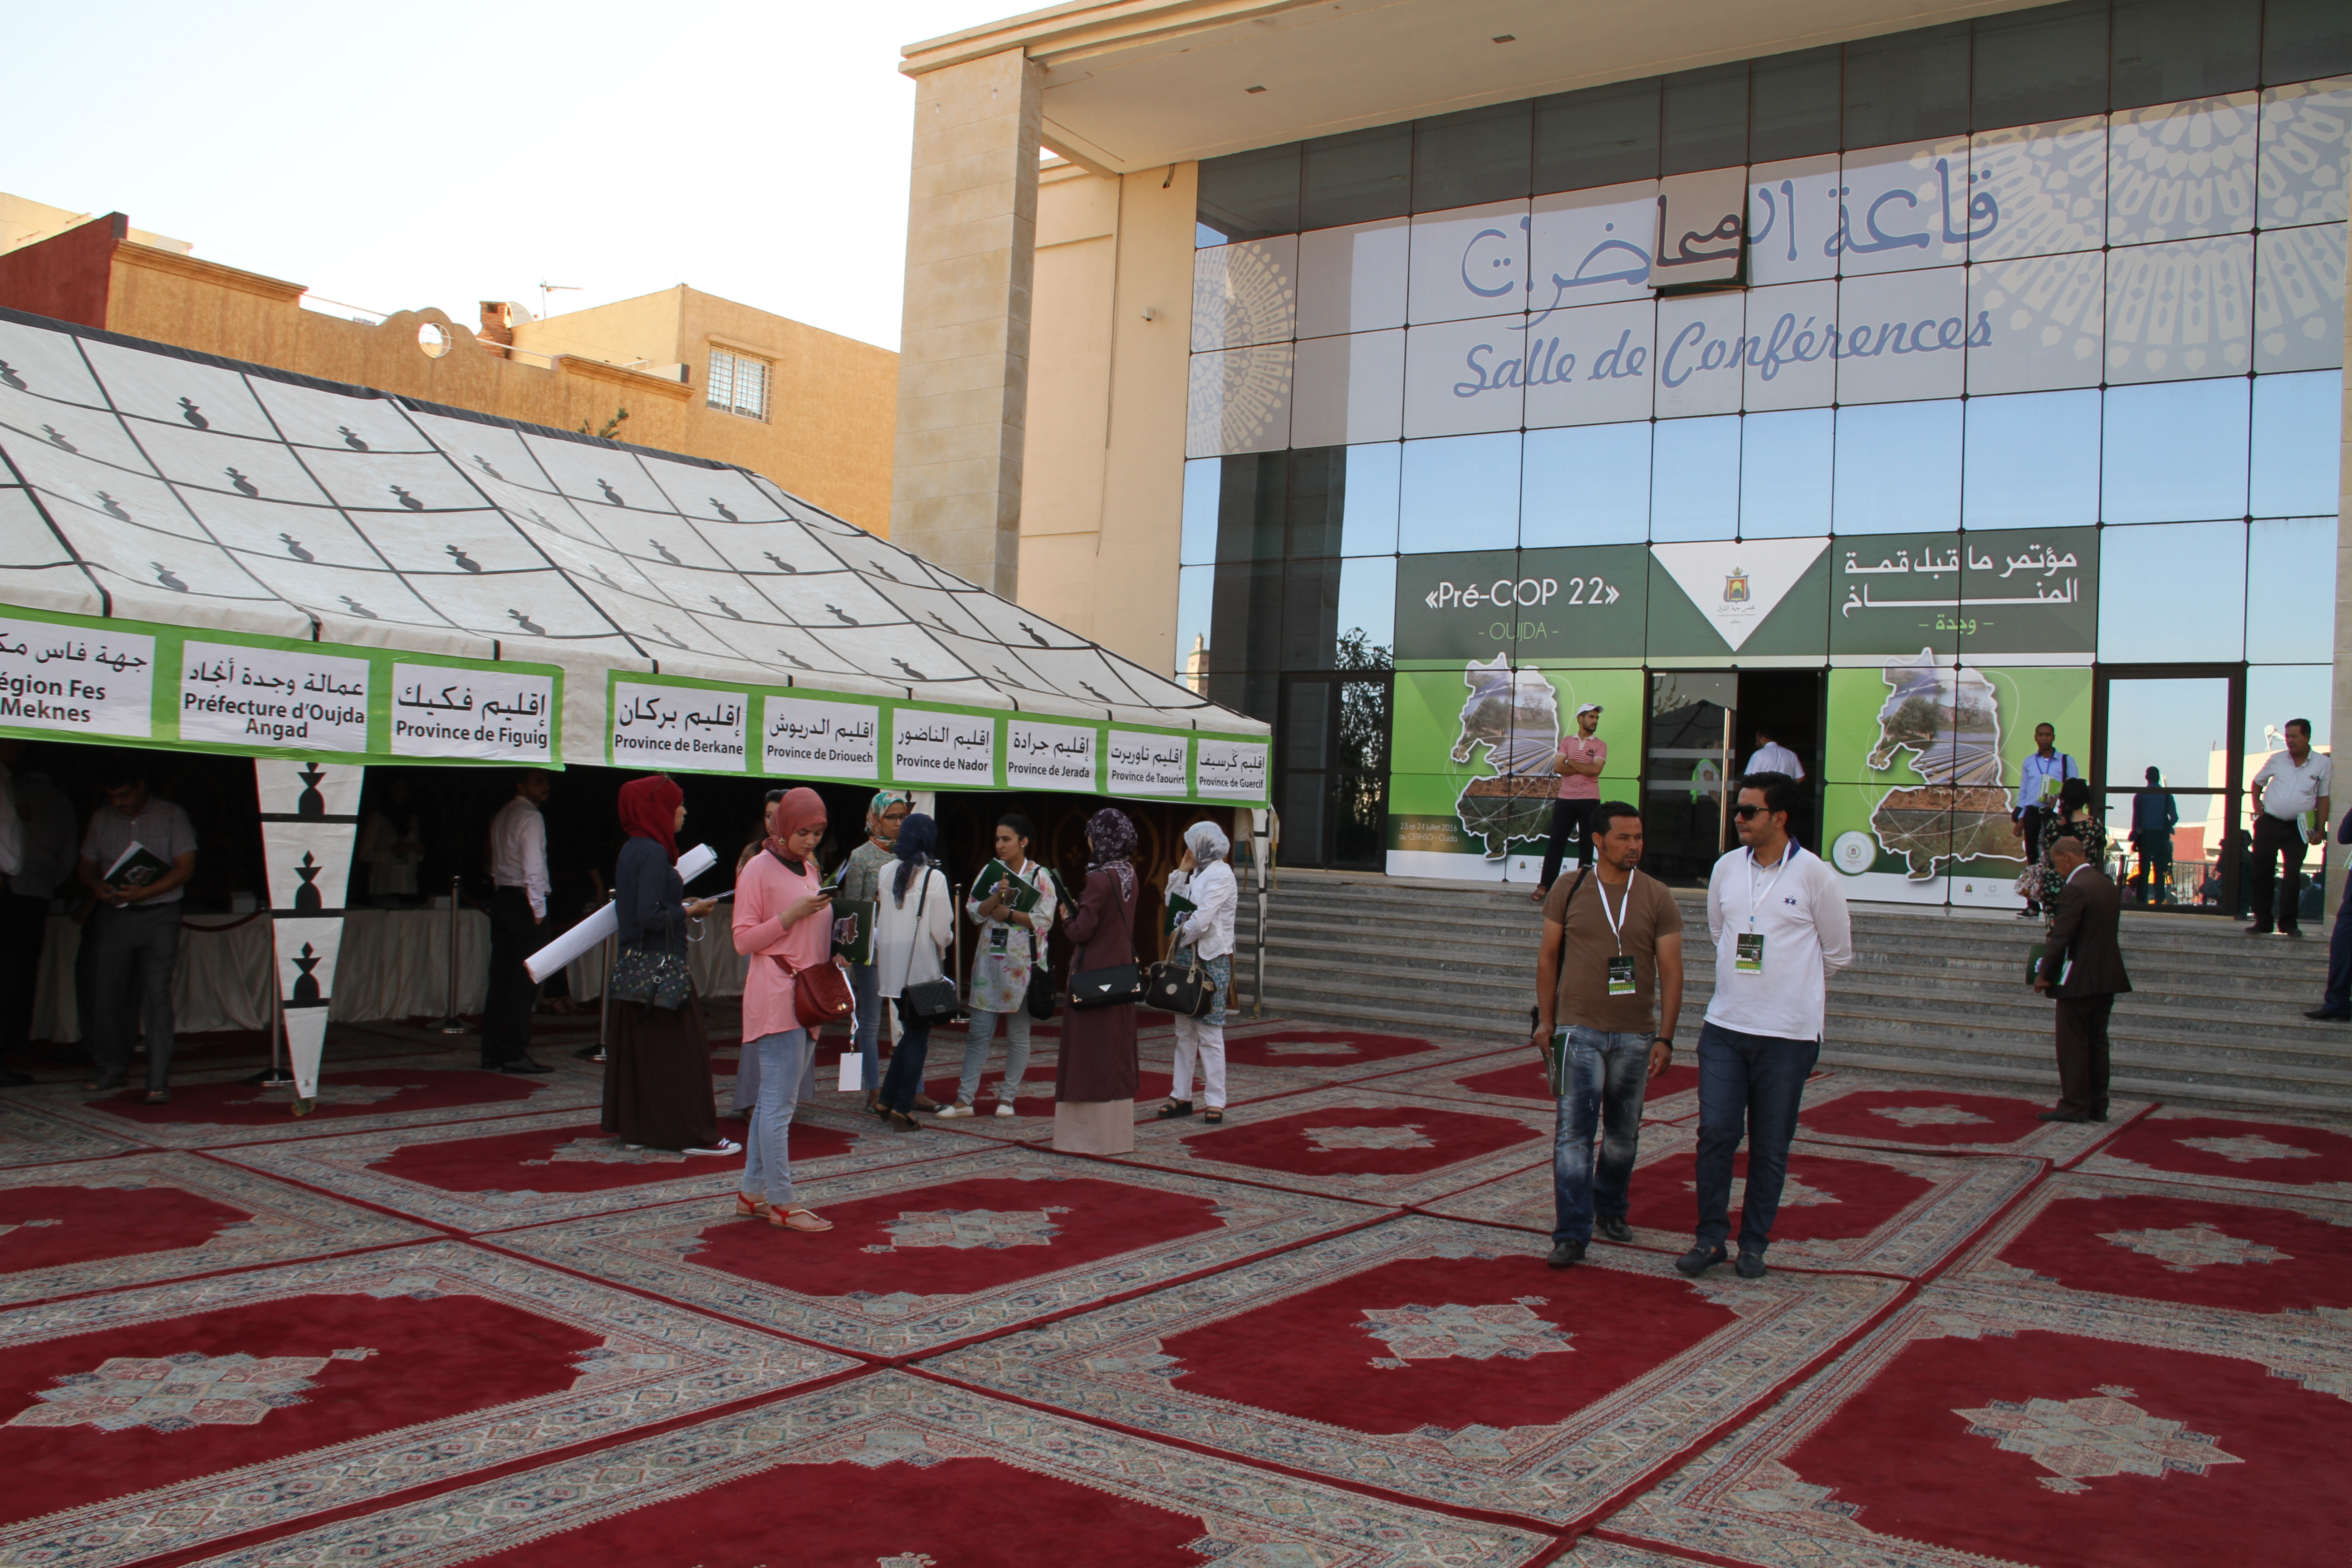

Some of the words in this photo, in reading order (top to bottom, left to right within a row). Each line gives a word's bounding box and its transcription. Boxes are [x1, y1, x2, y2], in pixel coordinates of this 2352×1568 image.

[1823, 157, 1999, 258] قاعة
[1460, 179, 1799, 331] المحاضرات
[1453, 336, 1577, 398] Salle
[1586, 328, 1648, 382] de
[1661, 310, 1994, 389] Conférences
[1844, 550, 1909, 574] قمة
[1913, 547, 1959, 580] قبل
[1968, 545, 1993, 570] ما
[1999, 544, 2078, 578] مؤتمر
[1935, 614, 1976, 635] وجدة
[36, 641, 88, 663] فاس
[96, 645, 148, 672] جهة
[189, 657, 235, 688] أنجاد
[241, 667, 295, 696] وجدة
[303, 673, 365, 696] عمالة
[0, 671, 63, 697] égion
[70, 679, 106, 700] Fes
[0, 697, 91, 722] Meknes
[184, 692, 286, 718] Préfecture
[398, 683, 473, 715] فكيك
[483, 691, 546, 727] إقليم
[619, 696, 677, 729] بركان
[685, 704, 740, 738] إقليم
[245, 718, 309, 740] Angad
[397, 720, 470, 740] Province
[475, 725, 495, 741] de
[499, 727, 548, 748] Figuig
[769, 713, 830, 739] الدريوش
[835, 721, 873, 746] إقليم
[898, 725, 949, 745] الناضور
[615, 735, 671, 750] Province
[675, 738, 690, 751] de
[693, 740, 743, 755] Berkane
[767, 745, 812, 759] Province
[814, 748, 827, 760] de
[829, 750, 873, 763] Driouech
[954, 730, 989, 754] إقليم
[1014, 731, 1049, 755] جرادة
[1054, 736, 1089, 762] إقليم
[1111, 745, 1149, 764] تاوريرت
[897, 754, 941, 768] Province
[943, 757, 956, 769] de
[958, 758, 988, 771] Nador
[1008, 762, 1046, 775] Province
[1049, 764, 1059, 776] de
[1061, 766, 1089, 778] Jerada
[1152, 747, 1182, 770] إقليم
[1240, 755, 1265, 775] إقليم
[1112, 770, 1144, 782] Province
[1146, 772, 1155, 783] de
[1156, 773, 1185, 784] Taourirt
[1199, 776, 1229, 787] Province
[1230, 778, 1239, 788] de
[1240, 778, 1264, 789] Guercif
